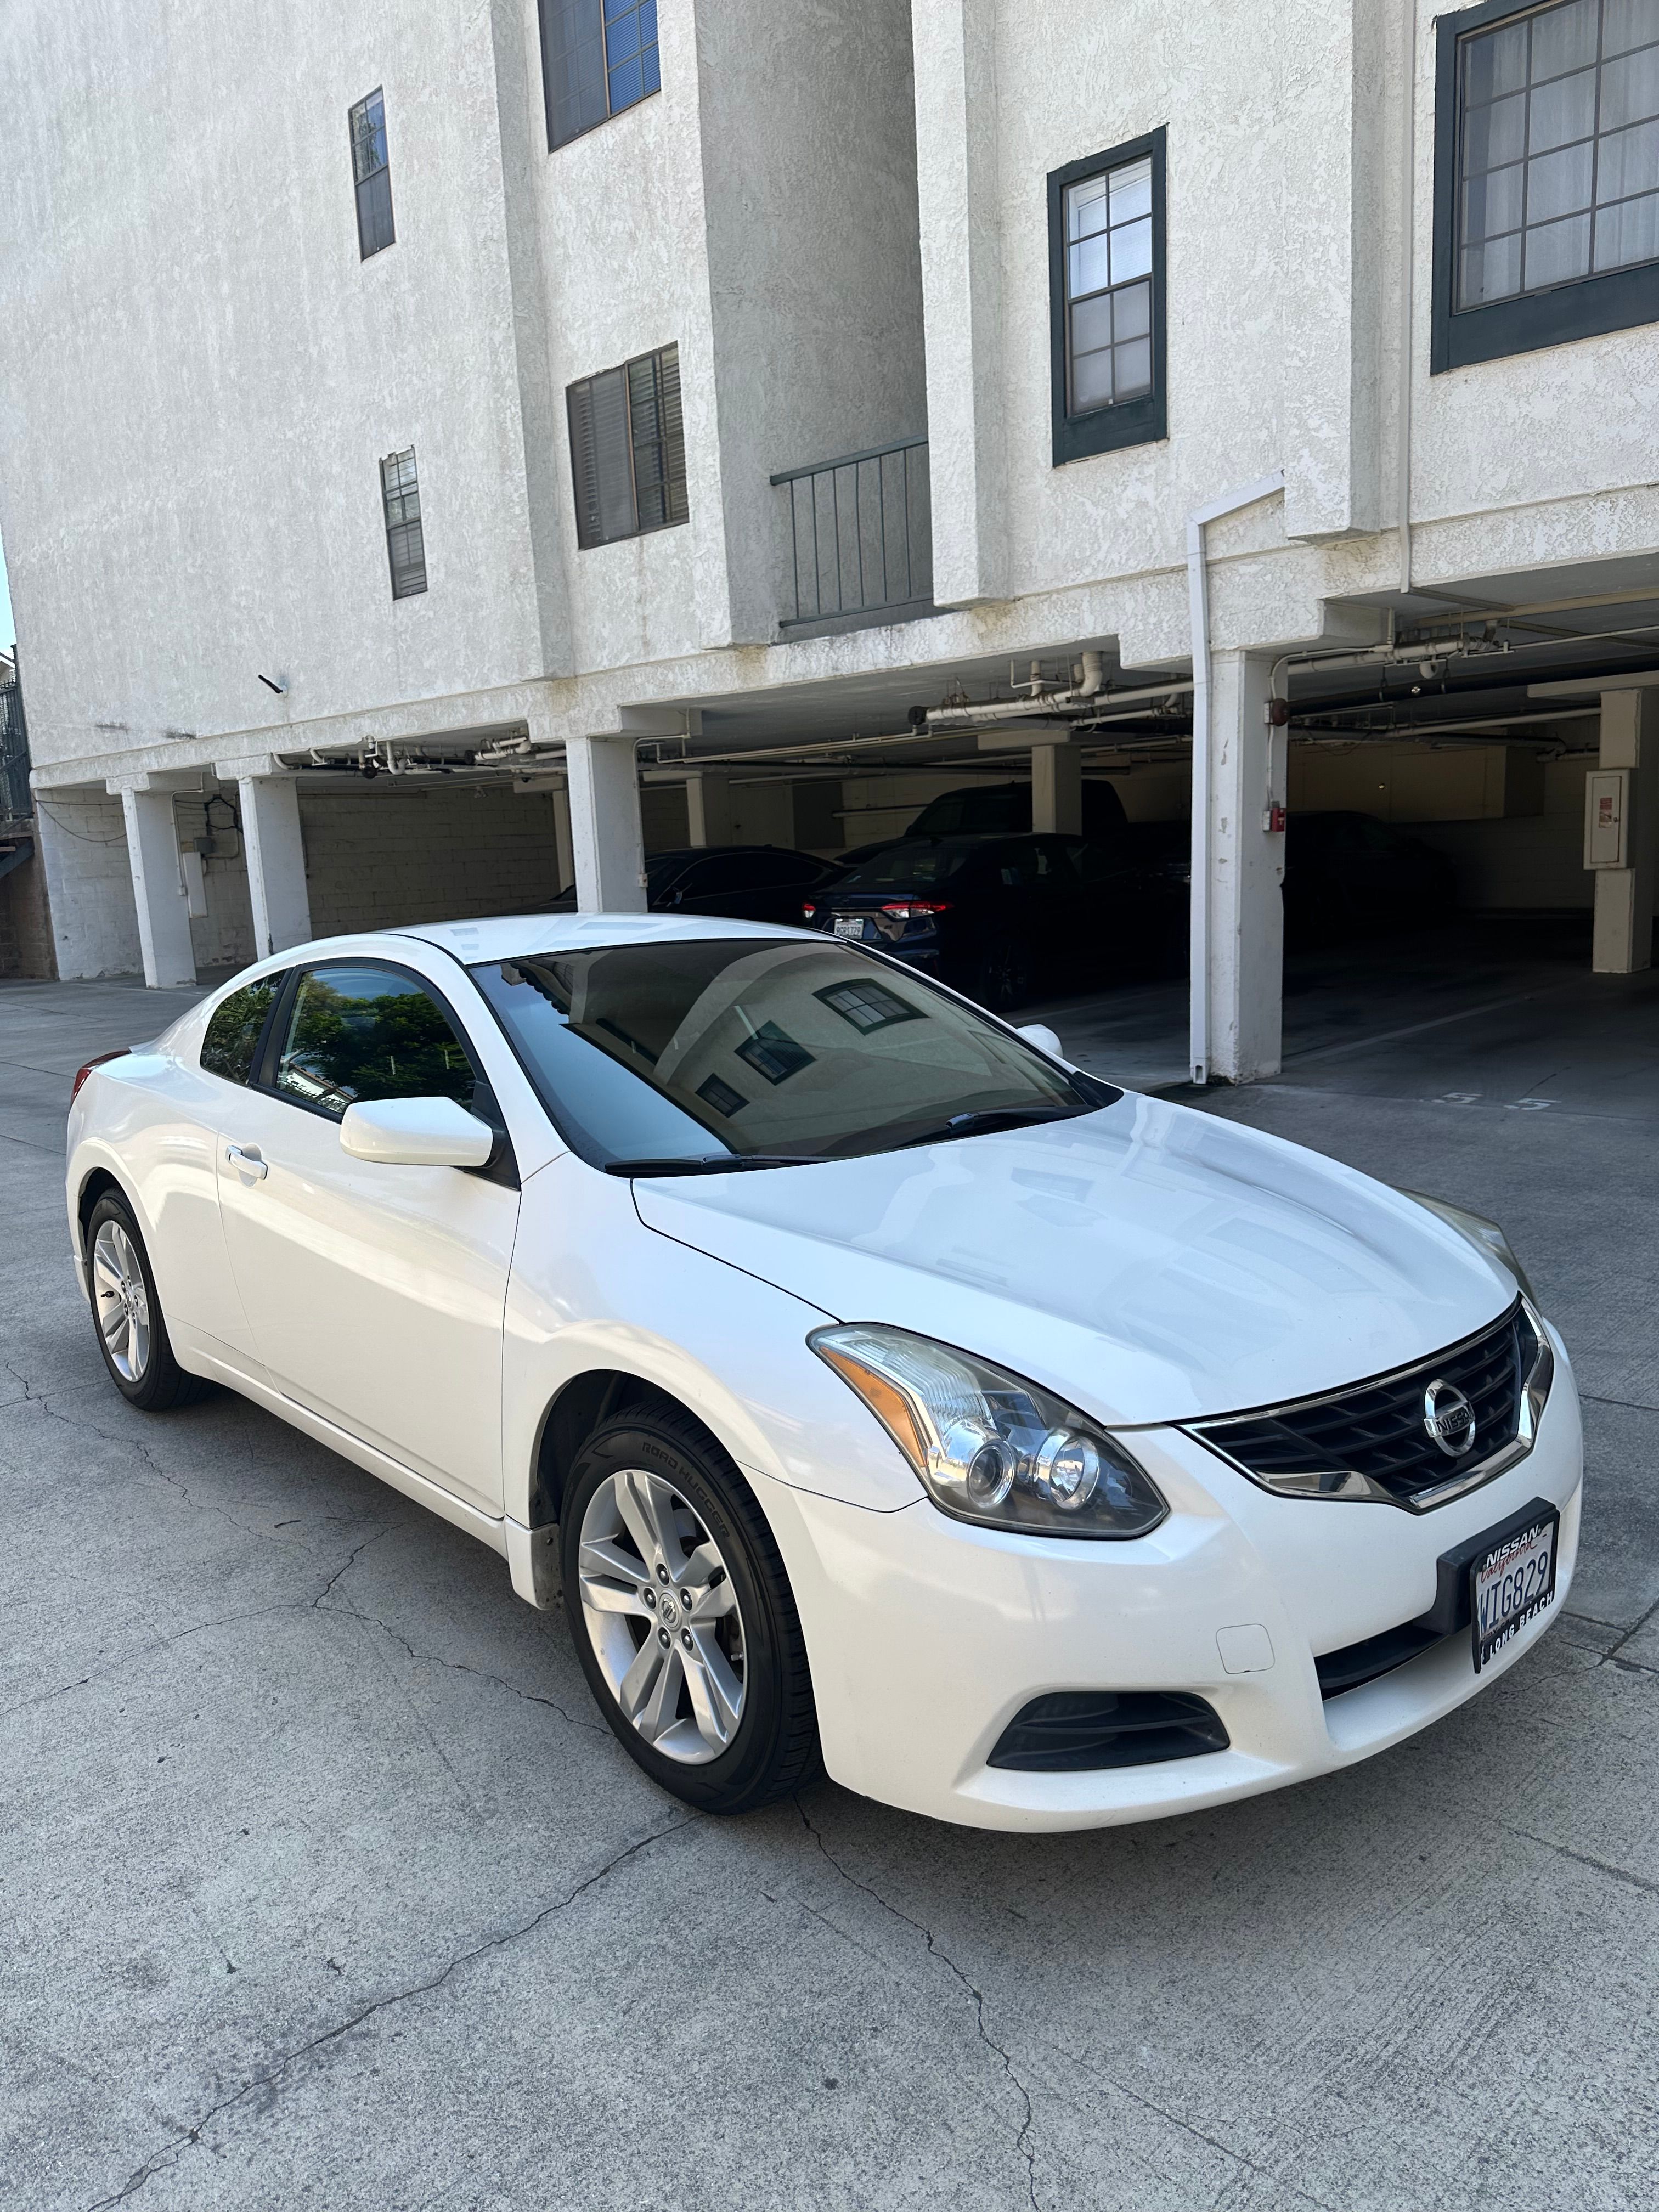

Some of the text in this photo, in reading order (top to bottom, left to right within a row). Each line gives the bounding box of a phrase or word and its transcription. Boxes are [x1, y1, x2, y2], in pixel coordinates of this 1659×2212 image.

[1436, 1412, 1471, 1432] NISSA
[642, 1442, 730, 1537] ROAD HUGGER
[1486, 1524, 1539, 1568] NISSAN
[1489, 1591, 1554, 1658] LONG BEACH
